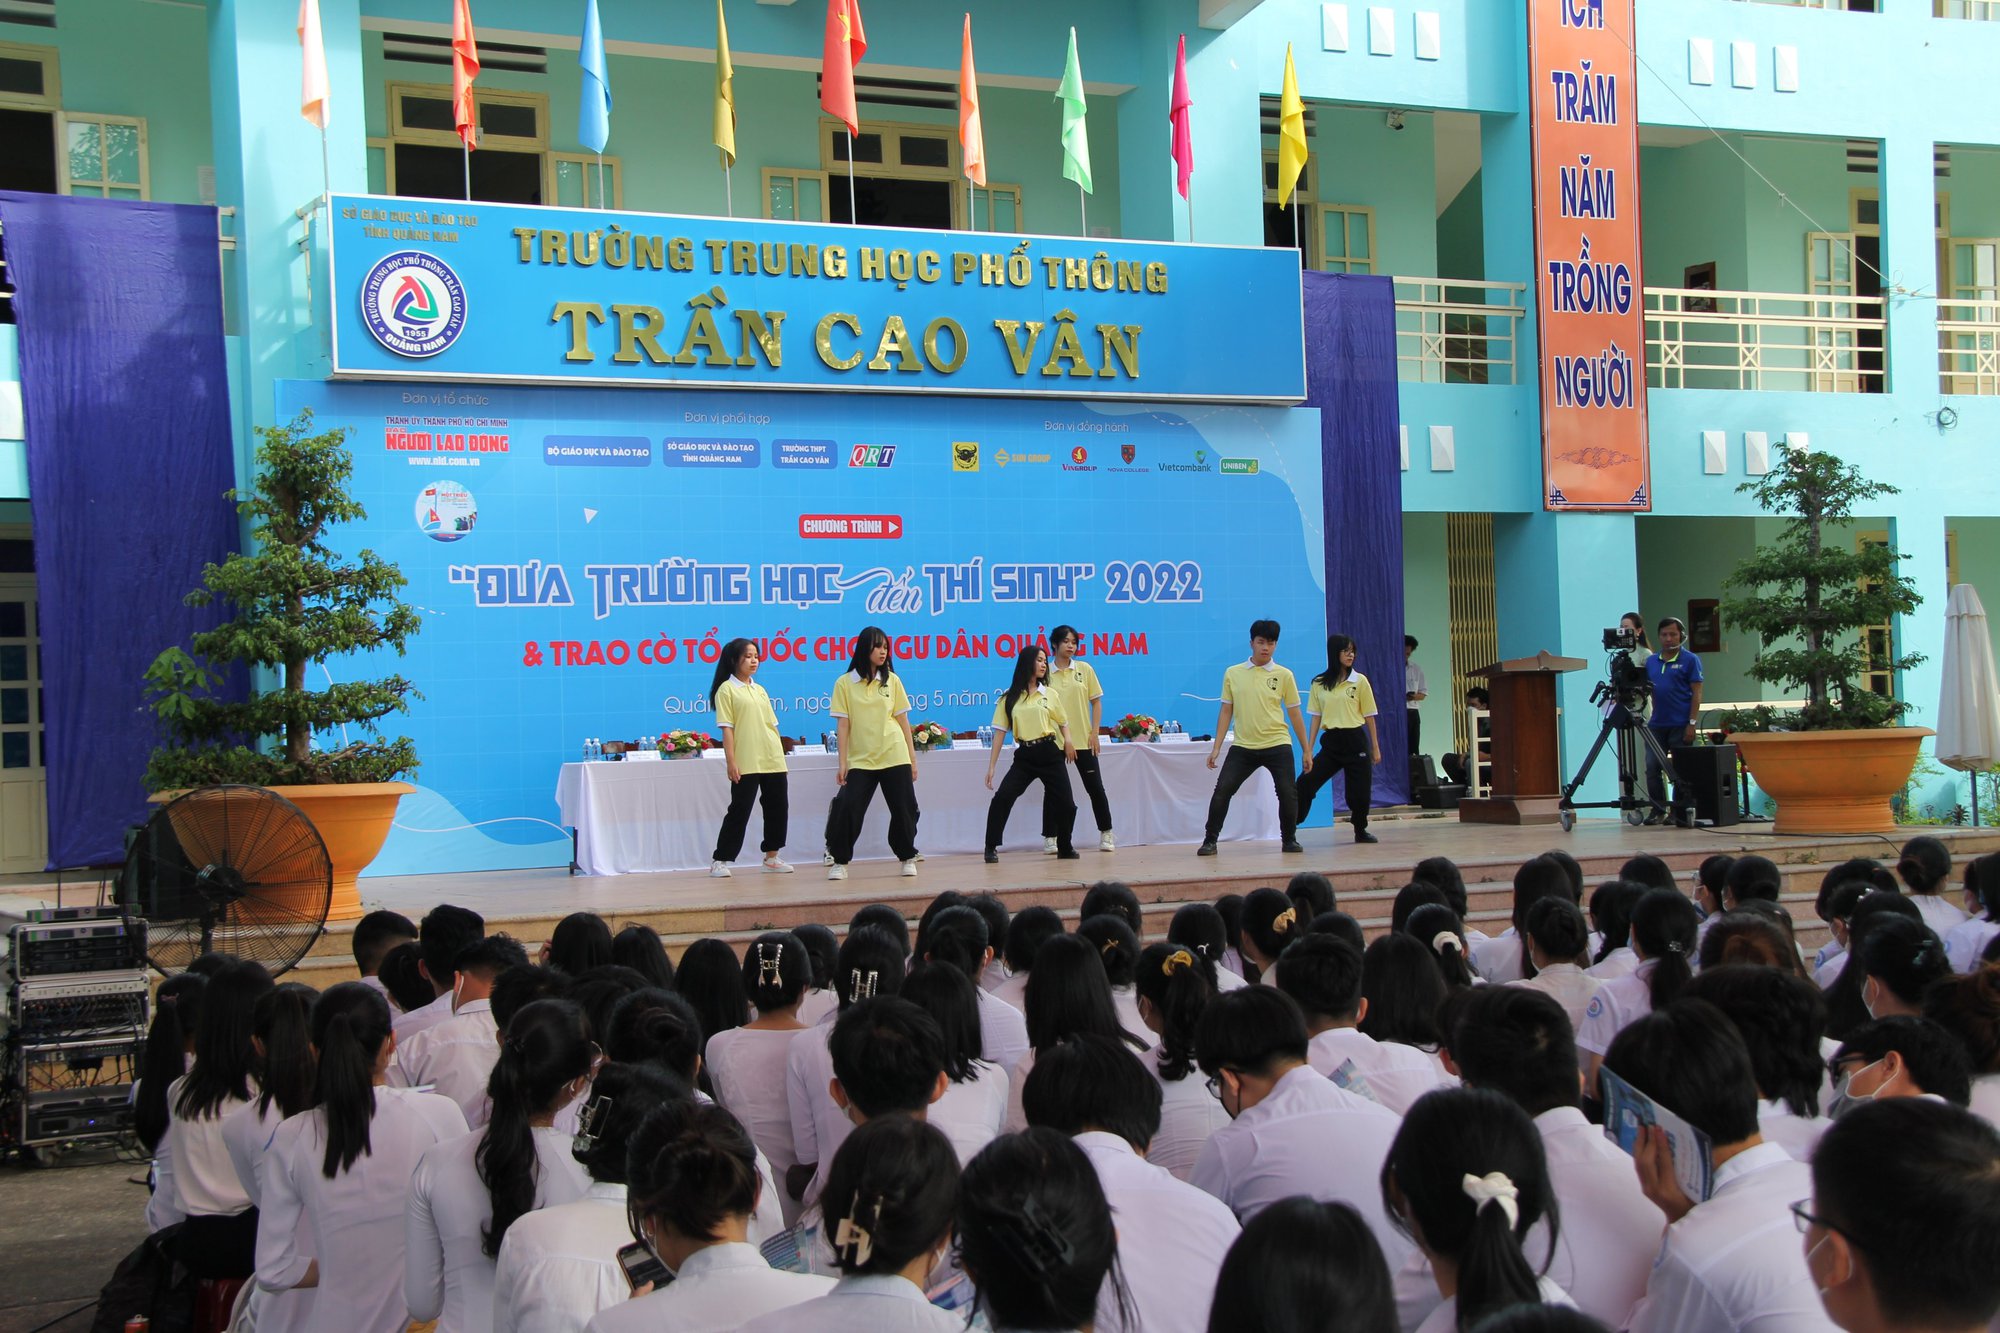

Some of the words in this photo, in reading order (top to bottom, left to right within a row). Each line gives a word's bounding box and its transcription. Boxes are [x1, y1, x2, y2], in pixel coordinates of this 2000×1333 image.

[1551, 59, 1617, 125] TRĂM
[1559, 154, 1616, 220] NĂM
[361, 207, 387, 221] GIÁO
[392, 226, 430, 241] QUẢNG
[433, 231, 458, 242] NAM
[513, 224, 694, 271] TRƯỜNG
[705, 239, 849, 278] TRUNG
[859, 247, 942, 290] HỌC
[954, 240, 1032, 287] PHỐ
[1043, 252, 1169, 295] THÔNG
[1548, 232, 1633, 315] TRỒNG
[370, 267, 388, 290] TRUNG
[386, 258, 403, 271] HỌC
[453, 296, 462, 312] CAO
[551, 285, 787, 368] TRẦN
[815, 312, 968, 374] CAO
[993, 308, 1143, 379] VÂN
[385, 333, 421, 352] QUẢNG
[423, 336, 447, 352] NAM
[1554, 340, 1634, 409] NGƯỜI
[402, 392, 428, 404] Đơn
[430, 393, 441, 407] vị
[444, 391, 456, 405] tổ
[459, 394, 489, 406] chức
[684, 411, 708, 423] Đơn
[710, 413, 720, 425] vị
[722, 411, 746, 425] phối
[748, 413, 771, 426] hợp
[1044, 420, 1065, 431] Đơn
[436, 434, 465, 451] LAO
[667, 441, 677, 450] SỞ
[678, 442, 697, 451] GIÁO
[697, 443, 711, 452] DỤC
[711, 442, 722, 451] VÀ
[723, 442, 739, 451] ĐÀO
[740, 444, 755, 452] TẠO
[810, 445, 826, 453] THPT
[547, 445, 560, 457] BỘ
[561, 445, 583, 456] GIÁO
[583, 447, 599, 458] DỤC
[599, 446, 612, 457] VÀ
[613, 447, 632, 457] ĐÀO
[632, 449, 650, 459] TẠO
[699, 453, 725, 463] QUẢNG
[725, 455, 742, 463] NAM
[799, 456, 814, 464] CAO
[851, 445, 895, 467] QRT
[408, 456, 480, 467] www.nld.com.vn
[1158, 462, 1211, 472] Vietcombank
[1222, 462, 1247, 470] UNIBEN
[803, 518, 848, 533] CHƯƠNG
[851, 518, 882, 534] TRÌNH
[585, 557, 750, 619] TRƯỜNG
[761, 563, 843, 609] HỌC
[838, 566, 922, 614] đến
[923, 556, 983, 616] THÍ
[1104, 561, 1203, 604] 2022
[523, 641, 543, 667] &
[550, 640, 630, 666] TRAO
[637, 631, 676, 665] CỜ
[683, 626, 721, 663] TỔ
[756, 626, 807, 662] UỐC
[888, 632, 931, 660] GƯ
[936, 628, 988, 659] DÂN
[1093, 632, 1149, 656] NAM
[795, 690, 831, 714] ngà
[933, 690, 943, 706] 5
[949, 689, 988, 706] năm
